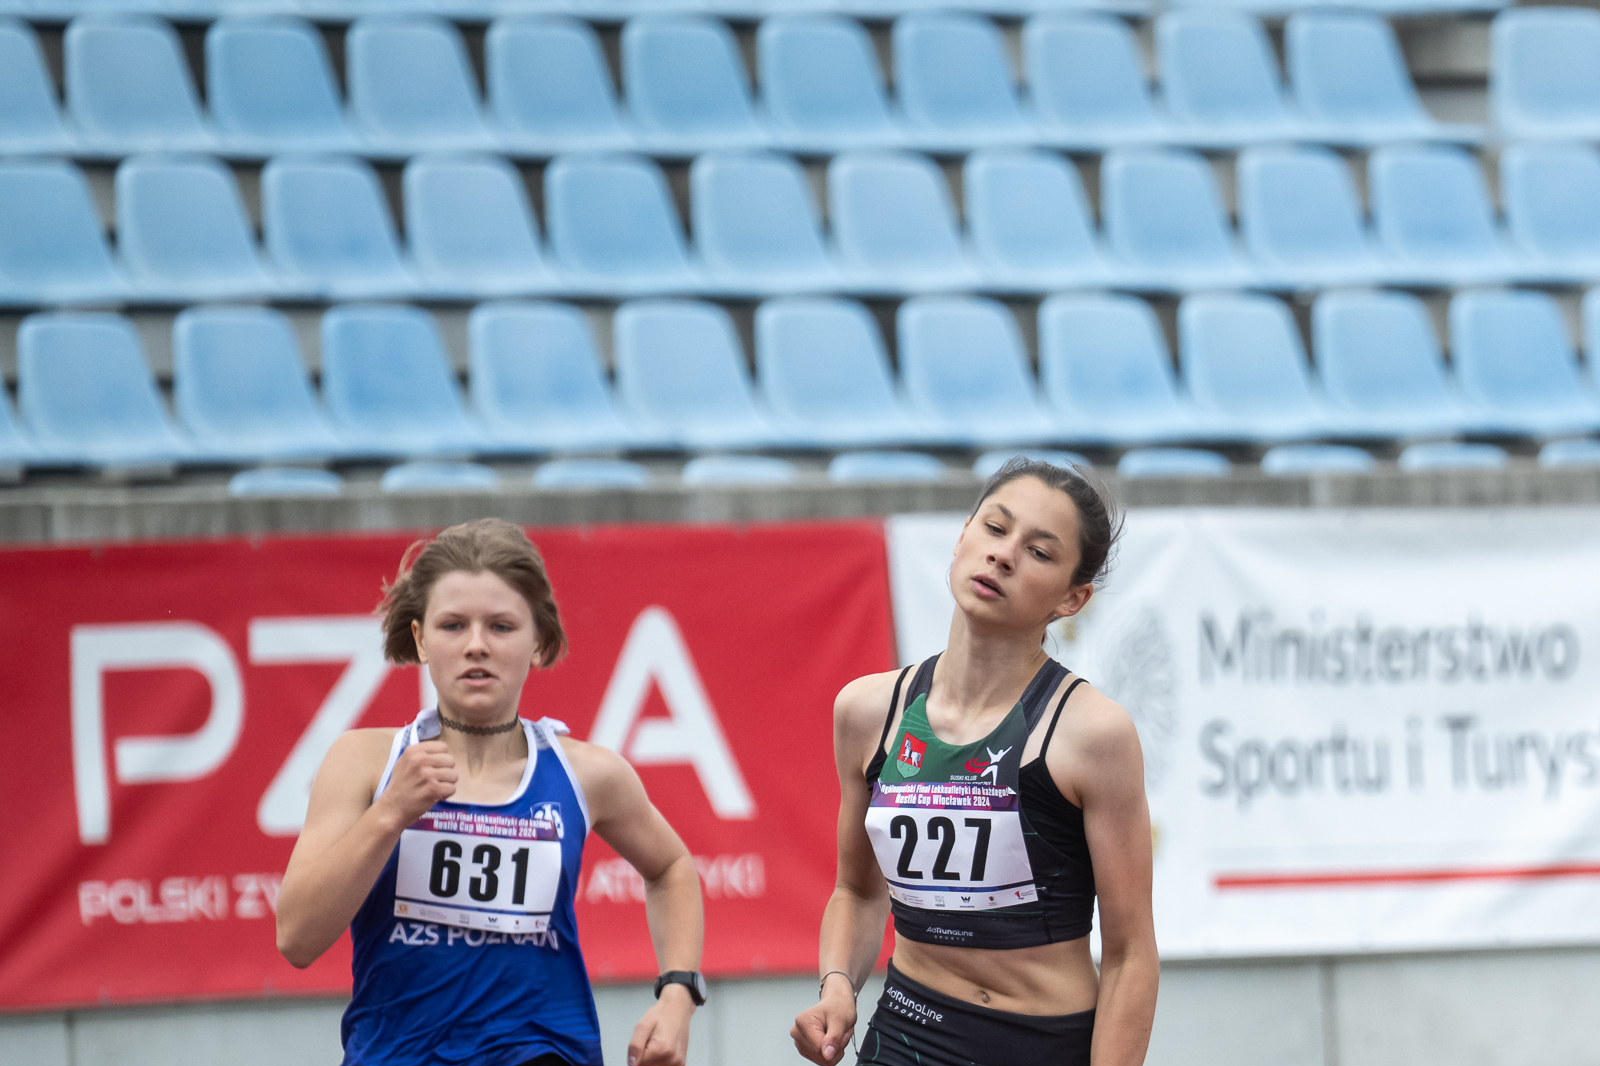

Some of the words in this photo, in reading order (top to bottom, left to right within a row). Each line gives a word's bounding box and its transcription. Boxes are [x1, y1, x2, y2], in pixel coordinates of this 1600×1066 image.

[1198, 608, 1581, 685] Ministerstwo
[69, 604, 758, 847] PZA
[1199, 714, 1391, 814] Sportu
[1405, 713, 1425, 793] i
[881, 784, 916, 794] Ogólnopolski
[916, 785, 931, 793] Finał
[931, 785, 970, 795] Lekkoatletyki
[972, 787, 981, 795] dla
[982, 787, 1009, 797] każdego!
[895, 794, 916, 804] Nestlé
[917, 795, 930, 806] Cup
[932, 795, 971, 806] Włocławek
[973, 796, 990, 806] 2024
[459, 821, 473, 834] Cup
[475, 822, 517, 836] Włocławek
[518, 827, 536, 838] 2024
[889, 815, 992, 881] 227
[429, 840, 530, 905] 631
[79, 875, 228, 927] POLSKI
[389, 922, 439, 946] AZS
[887, 986, 943, 1022] AdRunaLine
[889, 1001, 927, 1025] SPORTS
